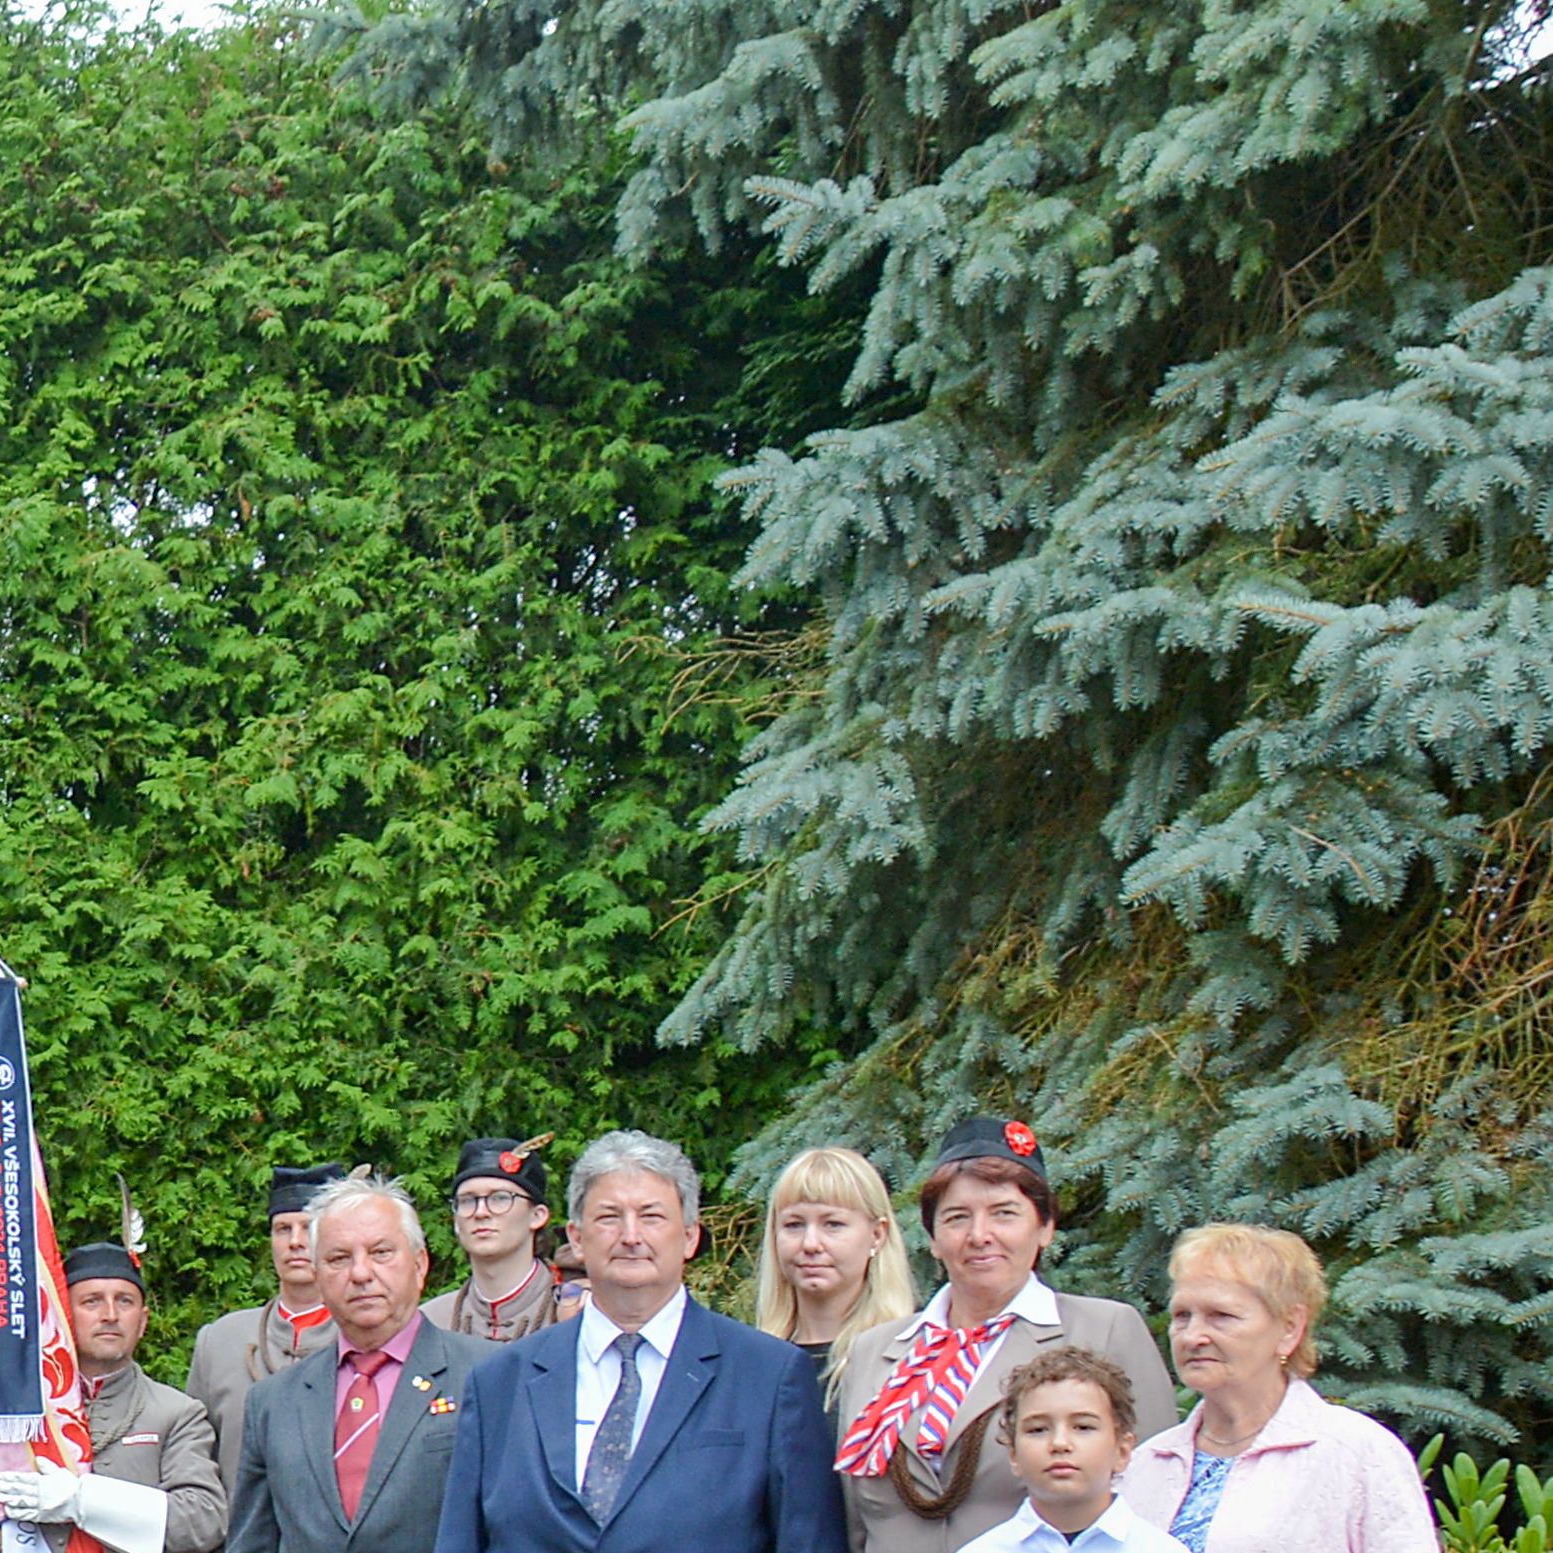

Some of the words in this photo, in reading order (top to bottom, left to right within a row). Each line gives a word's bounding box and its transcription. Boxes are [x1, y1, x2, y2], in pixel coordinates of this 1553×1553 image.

[1, 1099, 16, 1143] XVII.
[3, 1145, 26, 1286] VŠESOKOLSKÝ
[10, 1289, 26, 1339] SLET
